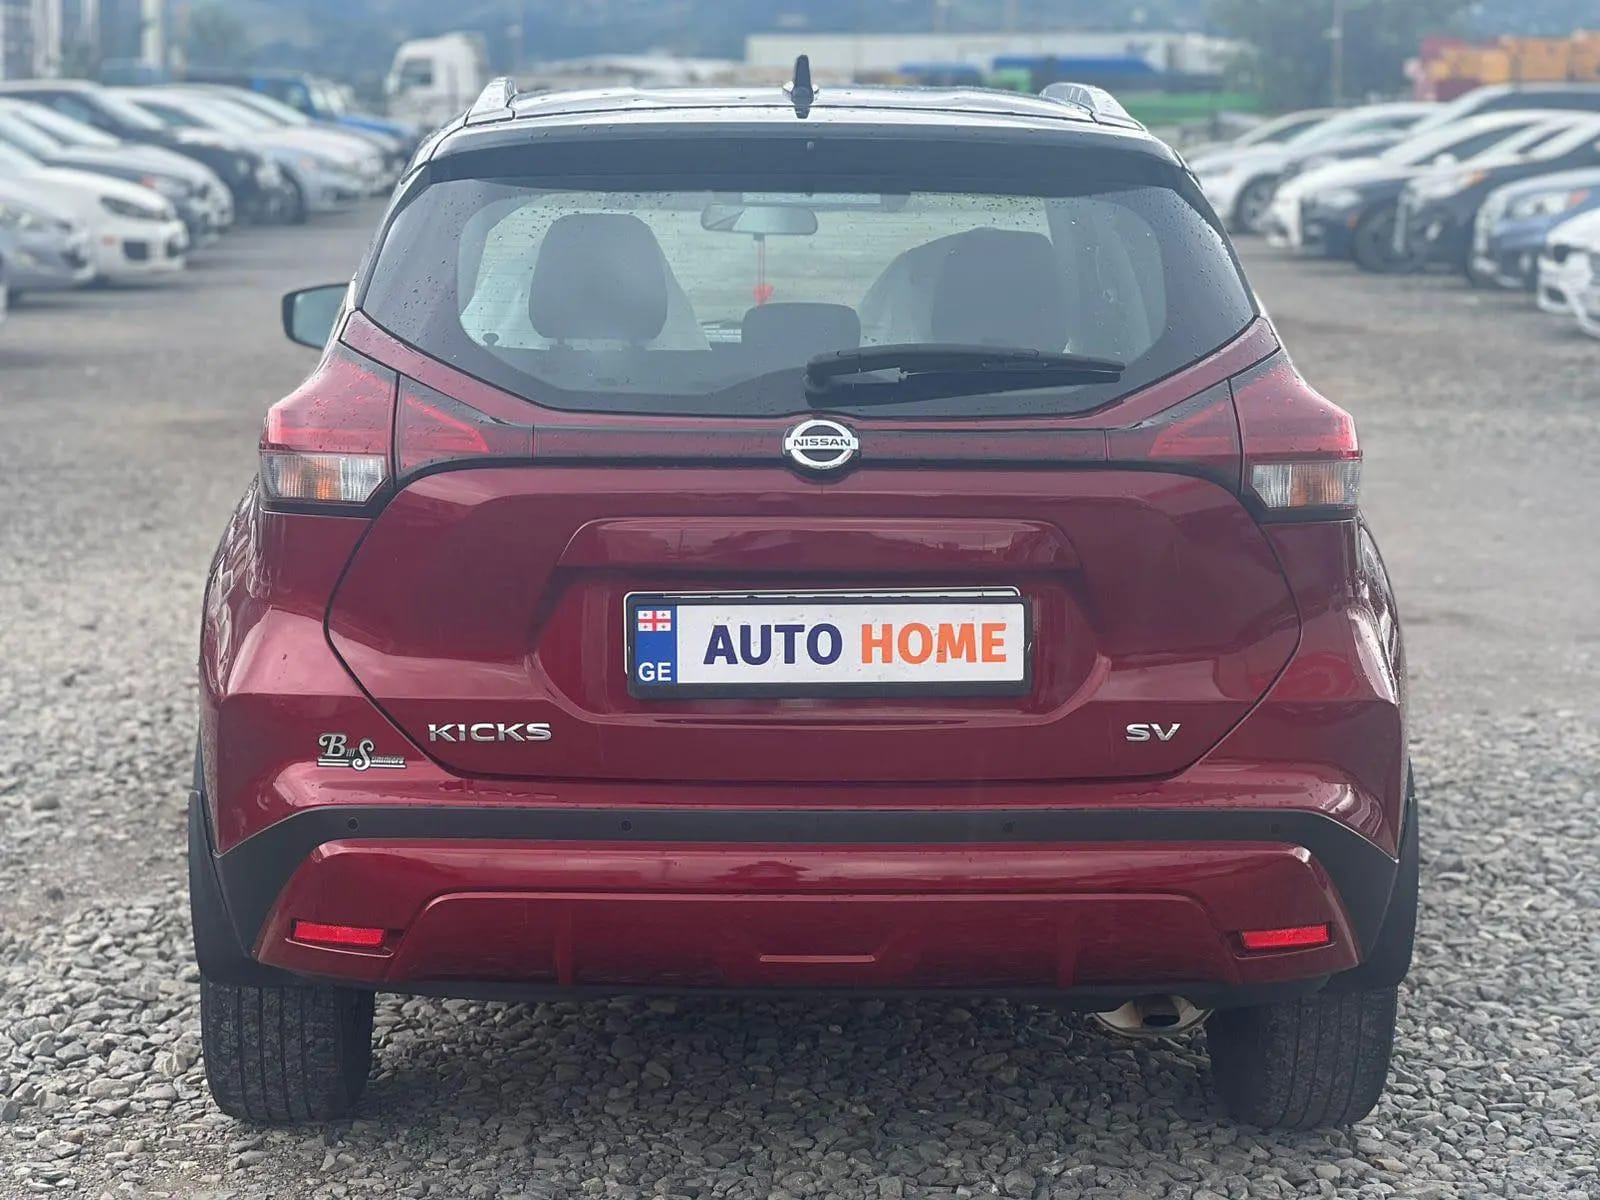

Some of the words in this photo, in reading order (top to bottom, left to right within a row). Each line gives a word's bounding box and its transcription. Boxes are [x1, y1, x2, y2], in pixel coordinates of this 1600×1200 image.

[793, 438, 852, 448] NISSAN
[703, 623, 843, 666] AUTO
[861, 622, 1007, 665] HOME
[637, 661, 672, 682] GE
[428, 723, 552, 742] KICKS
[1125, 723, 1181, 741] SV
[318, 734, 356, 757] Bill
